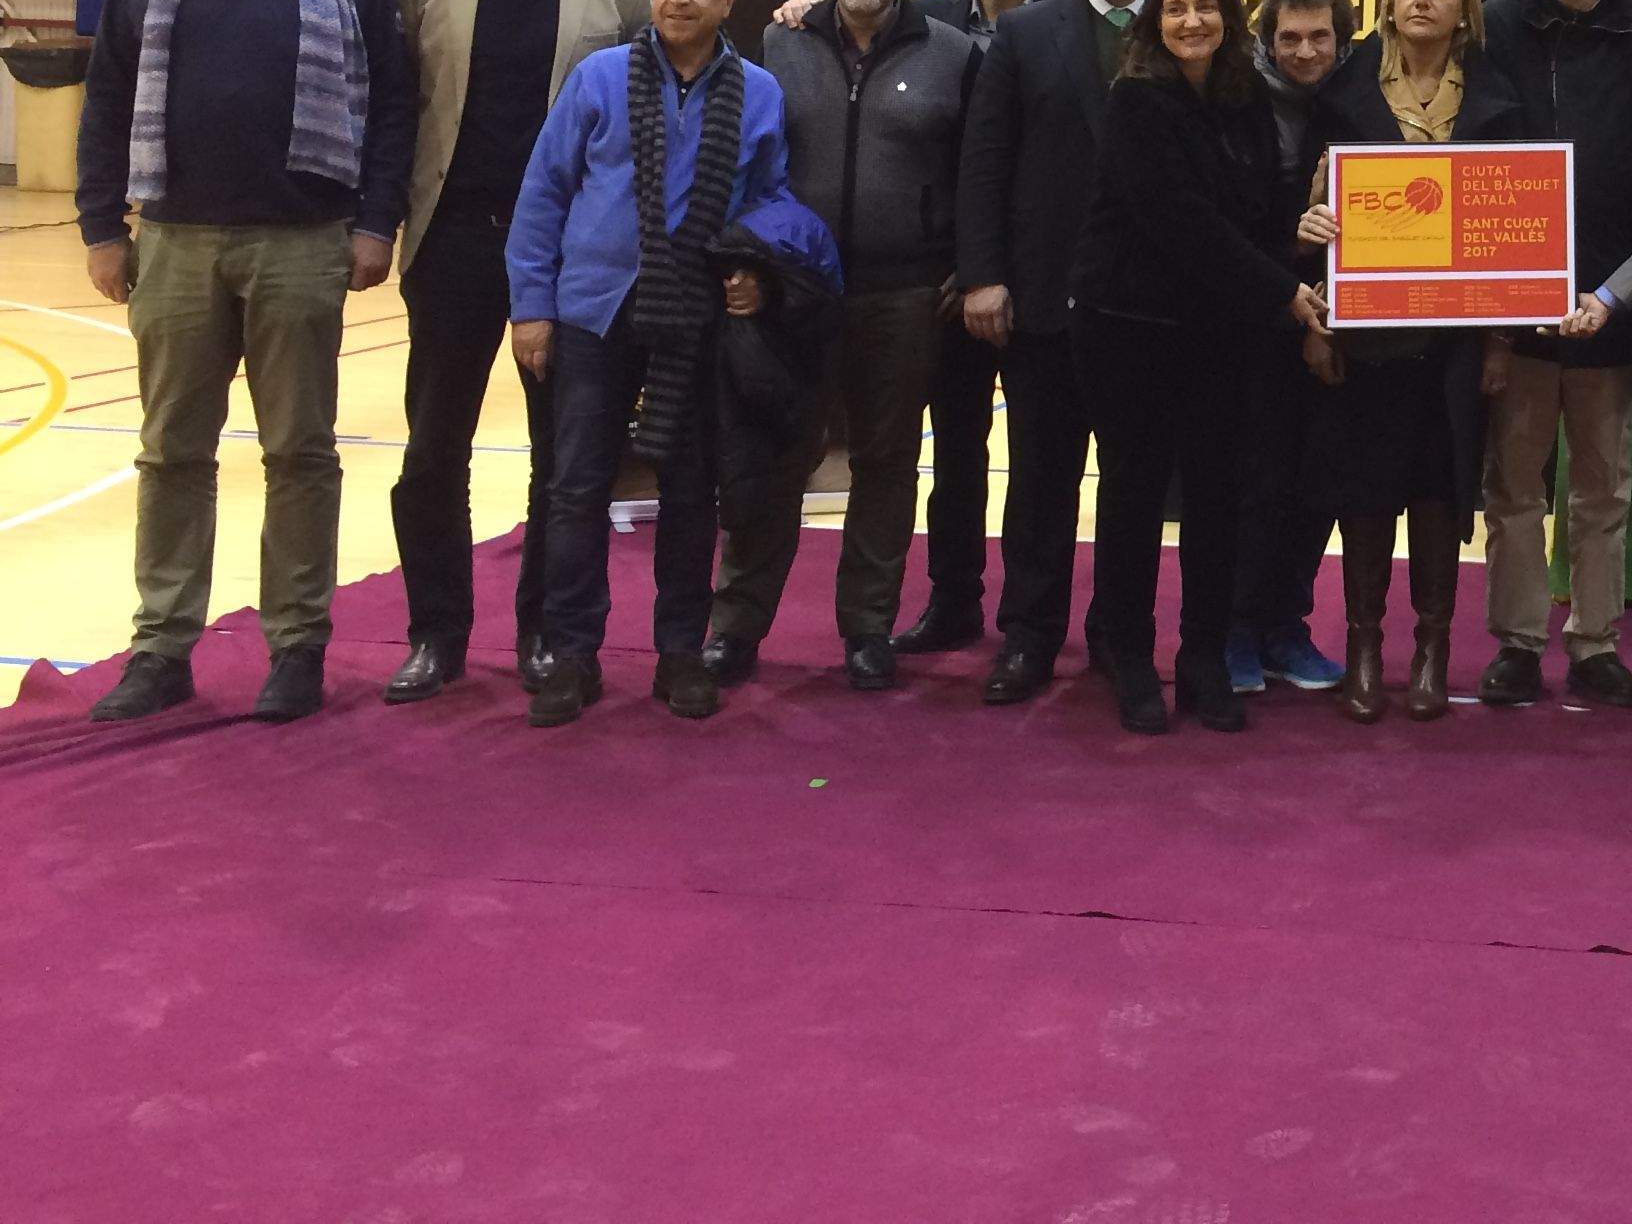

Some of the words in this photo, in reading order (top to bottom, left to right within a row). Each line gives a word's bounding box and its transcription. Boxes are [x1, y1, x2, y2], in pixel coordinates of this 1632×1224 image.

[1462, 165, 1511, 177] CIUTAT
[1462, 180, 1489, 191] DEL
[1494, 177, 1560, 191] BÀSQUET
[1462, 193, 1517, 206] CATALÀ
[1462, 217, 1499, 229] SANT
[1503, 216, 1549, 229] CUGAT
[1463, 232, 1491, 244] DEL
[1463, 246, 1497, 258] 2017
